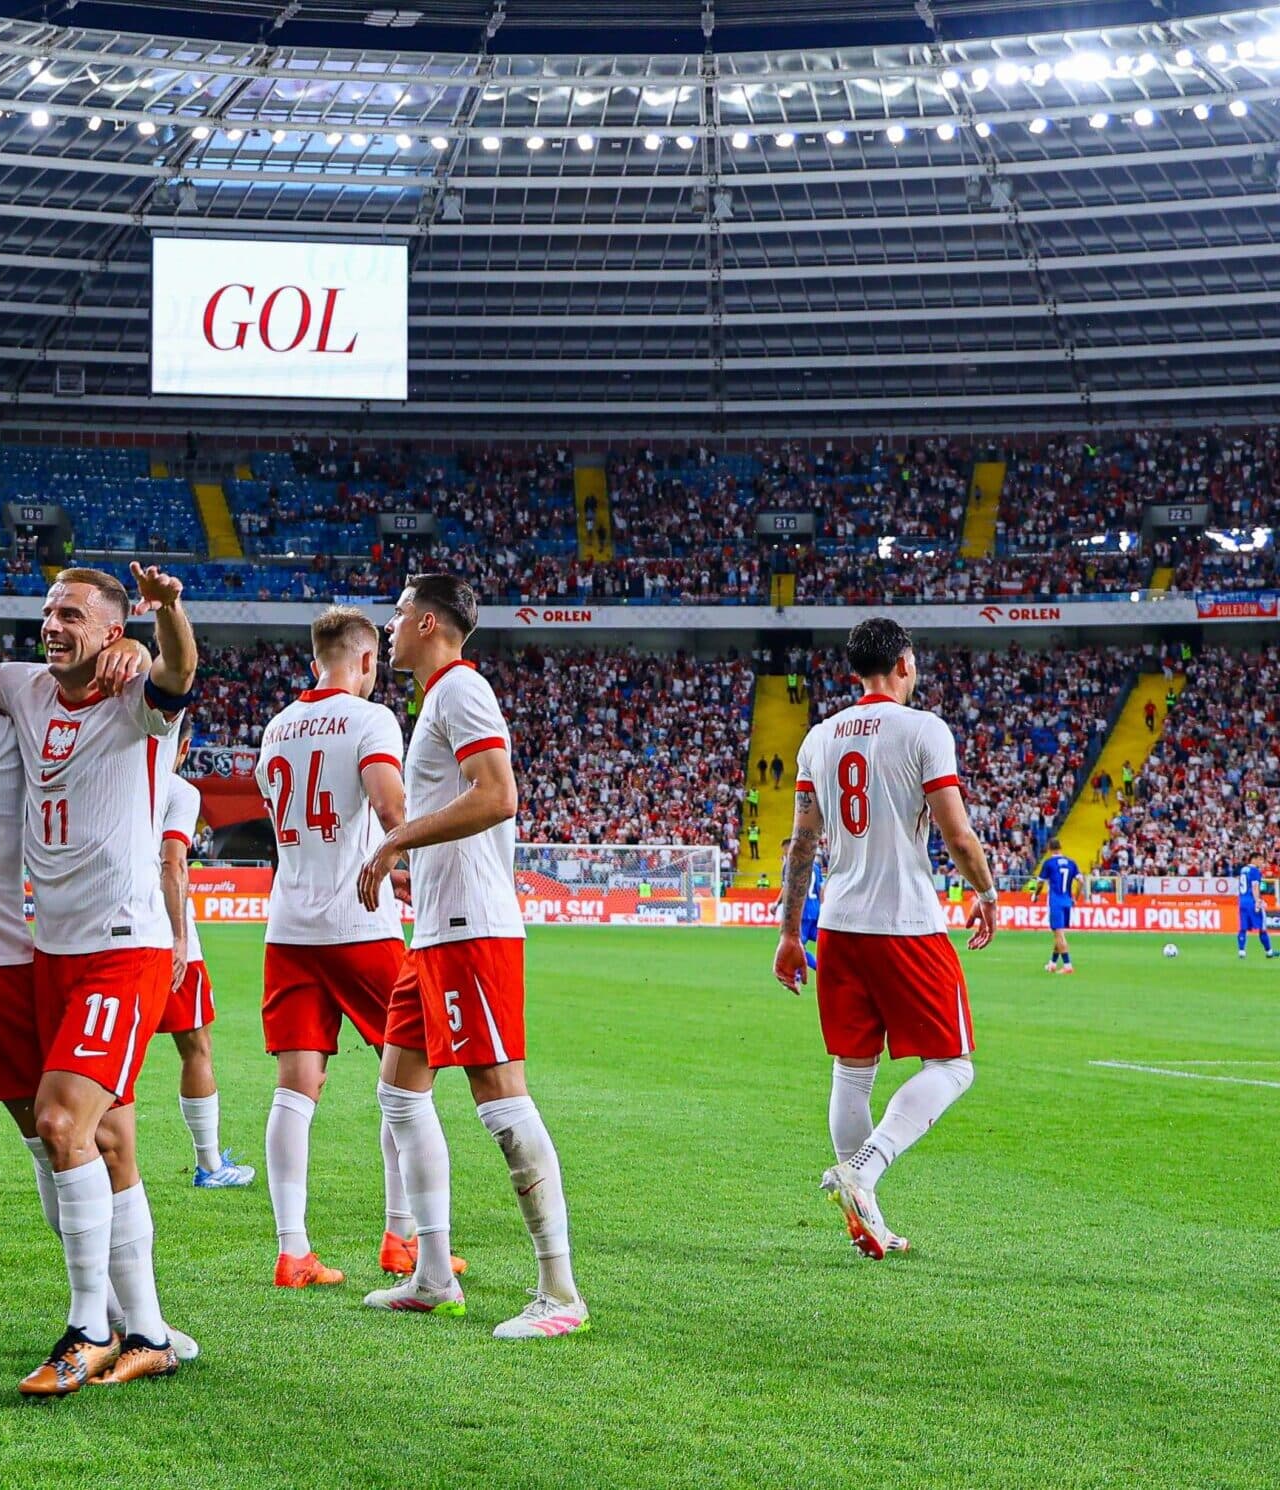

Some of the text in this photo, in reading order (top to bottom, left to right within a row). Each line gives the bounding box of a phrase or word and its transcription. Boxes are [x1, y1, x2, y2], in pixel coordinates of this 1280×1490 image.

[203, 283, 359, 353] GOL
[24, 509, 34, 518] 19
[776, 518, 786, 528] 21
[1170, 510, 1181, 520] 22
[543, 610, 592, 622] ORLEN
[1009, 607, 1060, 620] ORLEN
[833, 718, 881, 739] MODER
[267, 749, 341, 847] 24
[838, 751, 871, 839] 8
[41, 799, 69, 846] 11
[1059, 868, 1069, 893] 7
[1145, 908, 1221, 929] POLSKI
[83, 993, 120, 1043] 11
[444, 990, 462, 1032] 5
